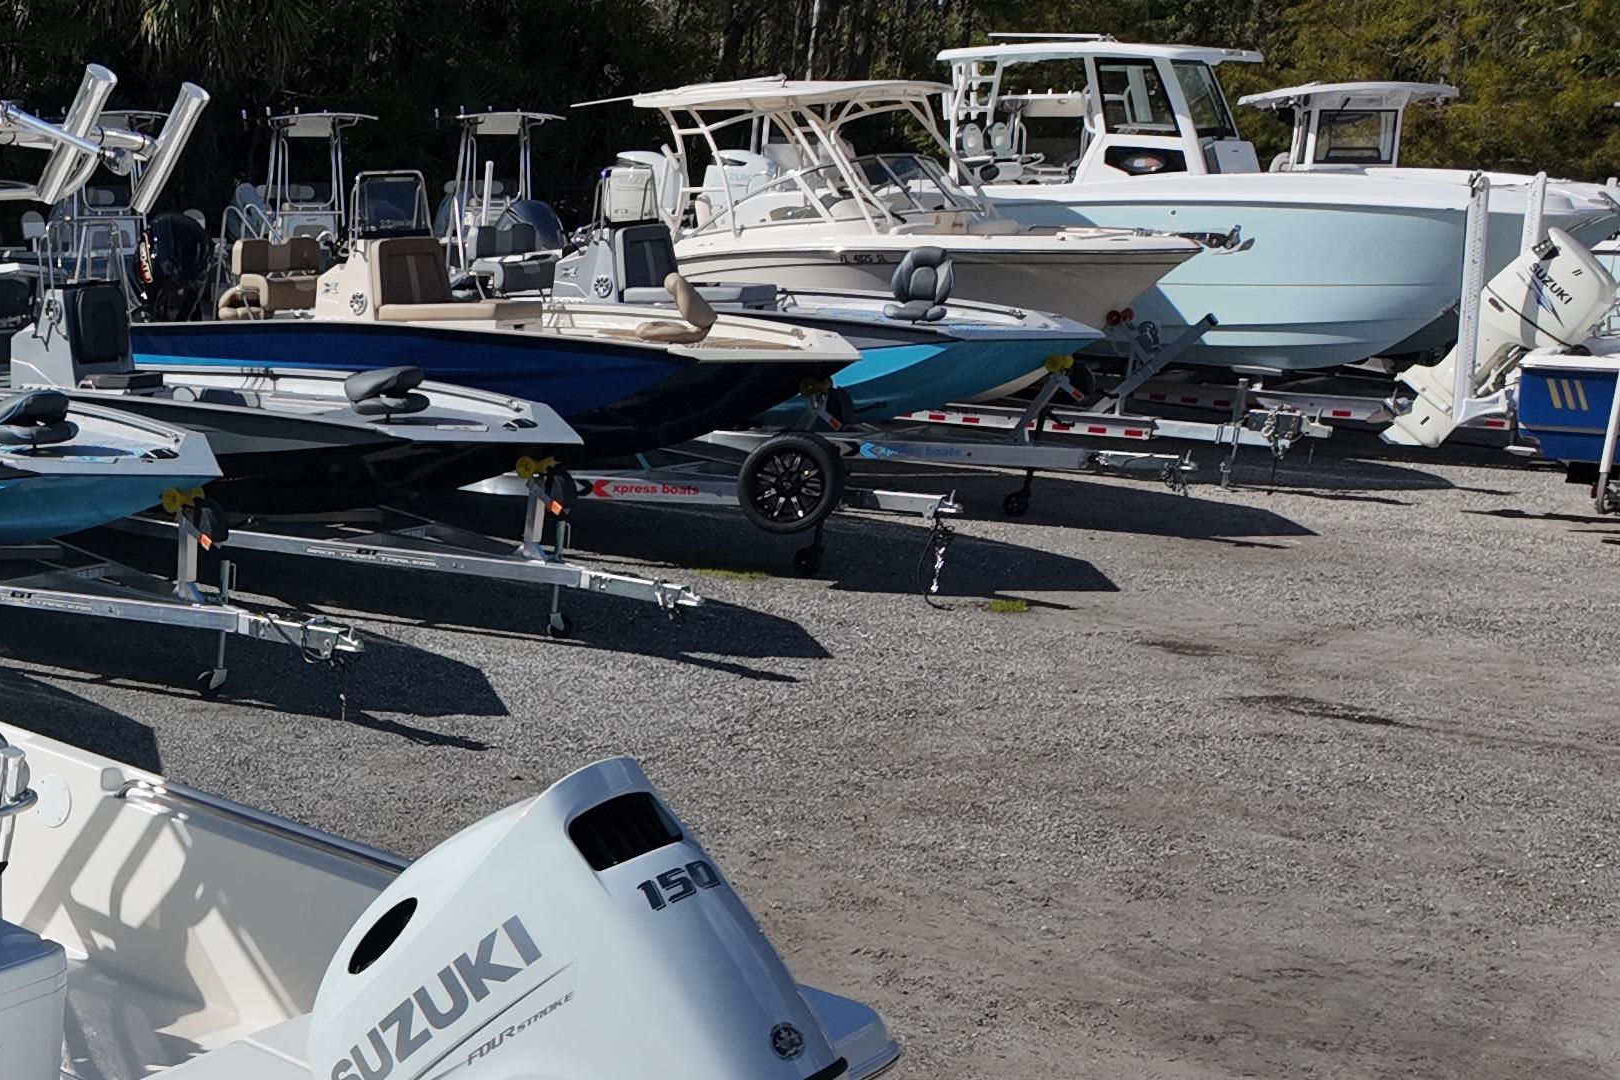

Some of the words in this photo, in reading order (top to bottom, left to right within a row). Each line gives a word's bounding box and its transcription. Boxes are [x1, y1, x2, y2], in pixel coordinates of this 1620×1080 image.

[1530, 262, 1573, 305] SUZUKI
[612, 483, 658, 495] xpress
[662, 484, 700, 495] boats
[636, 860, 721, 911] 150
